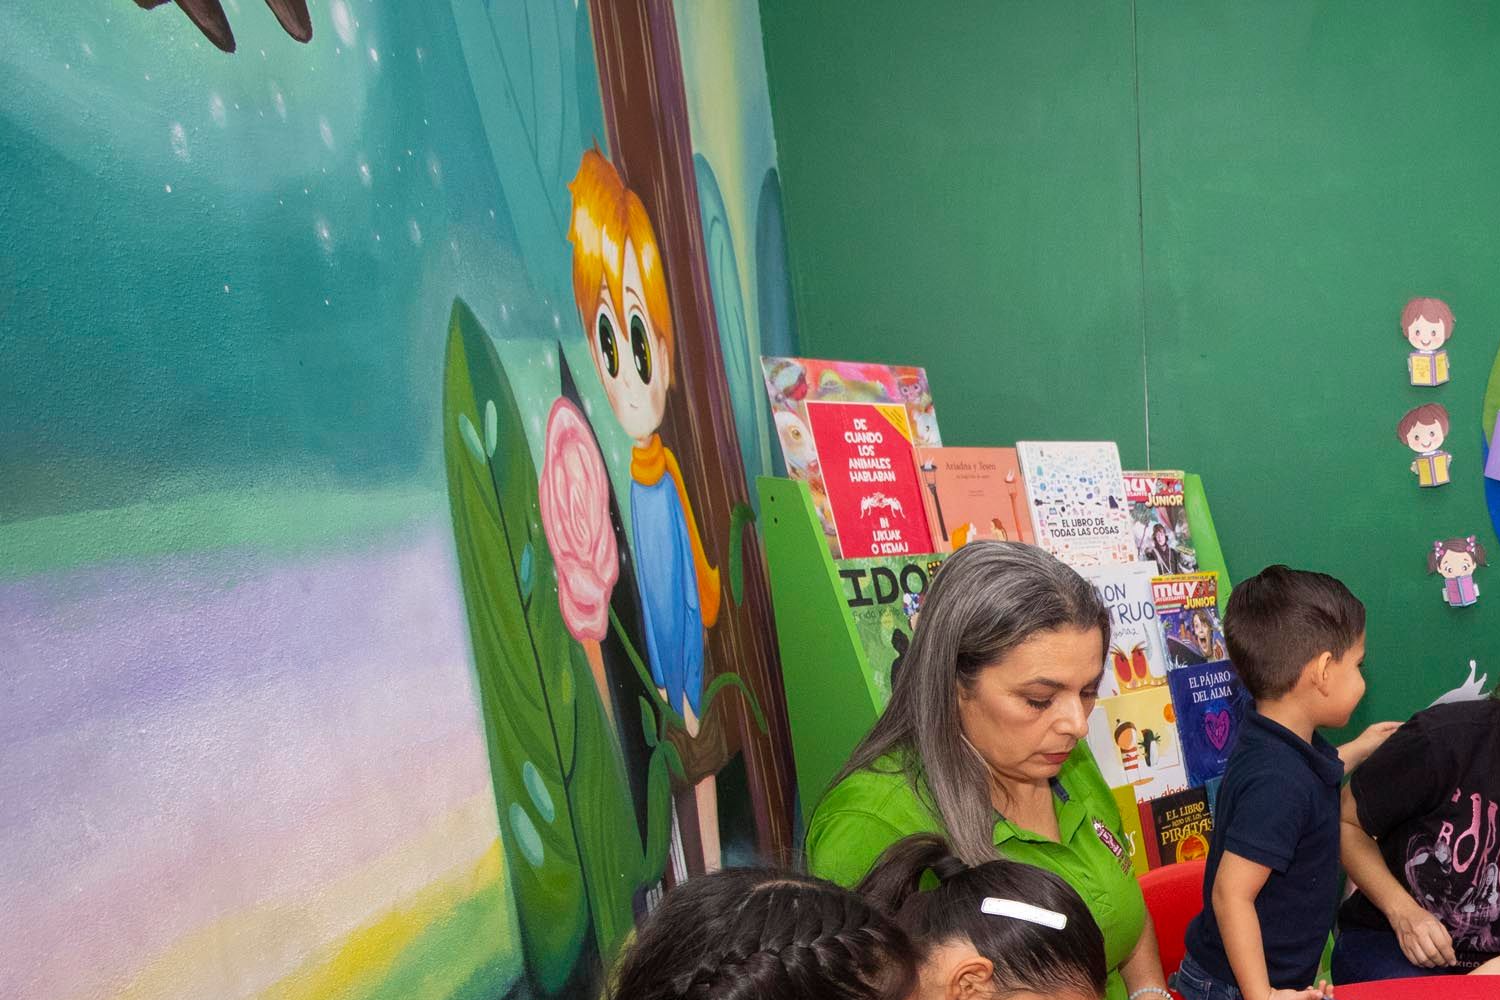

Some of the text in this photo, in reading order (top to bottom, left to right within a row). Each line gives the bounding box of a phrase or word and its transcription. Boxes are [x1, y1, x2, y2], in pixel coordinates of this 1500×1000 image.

[853, 418, 867, 430] DE
[844, 432, 883, 443] CUANDO
[858, 445, 875, 456] LOS
[848, 458, 891, 469] ANIMALES
[849, 471, 896, 482] HABLABAN
[1145, 494, 1184, 507] JUNIOR
[879, 518, 889, 528] IN
[1061, 517, 1105, 527] EL LIBRO DE
[1050, 525, 1119, 537] TODAS LAS COSAS
[871, 543, 879, 554] O
[1104, 583, 1126, 601] ON
[1184, 596, 1216, 609] JUNIOR
[1189, 670, 1231, 689] EL PÁJARO
[1192, 686, 1232, 703] DEL ALMA
[1166, 801, 1205, 820] EL LIBRO
[1161, 818, 1213, 845] PIRATAS
